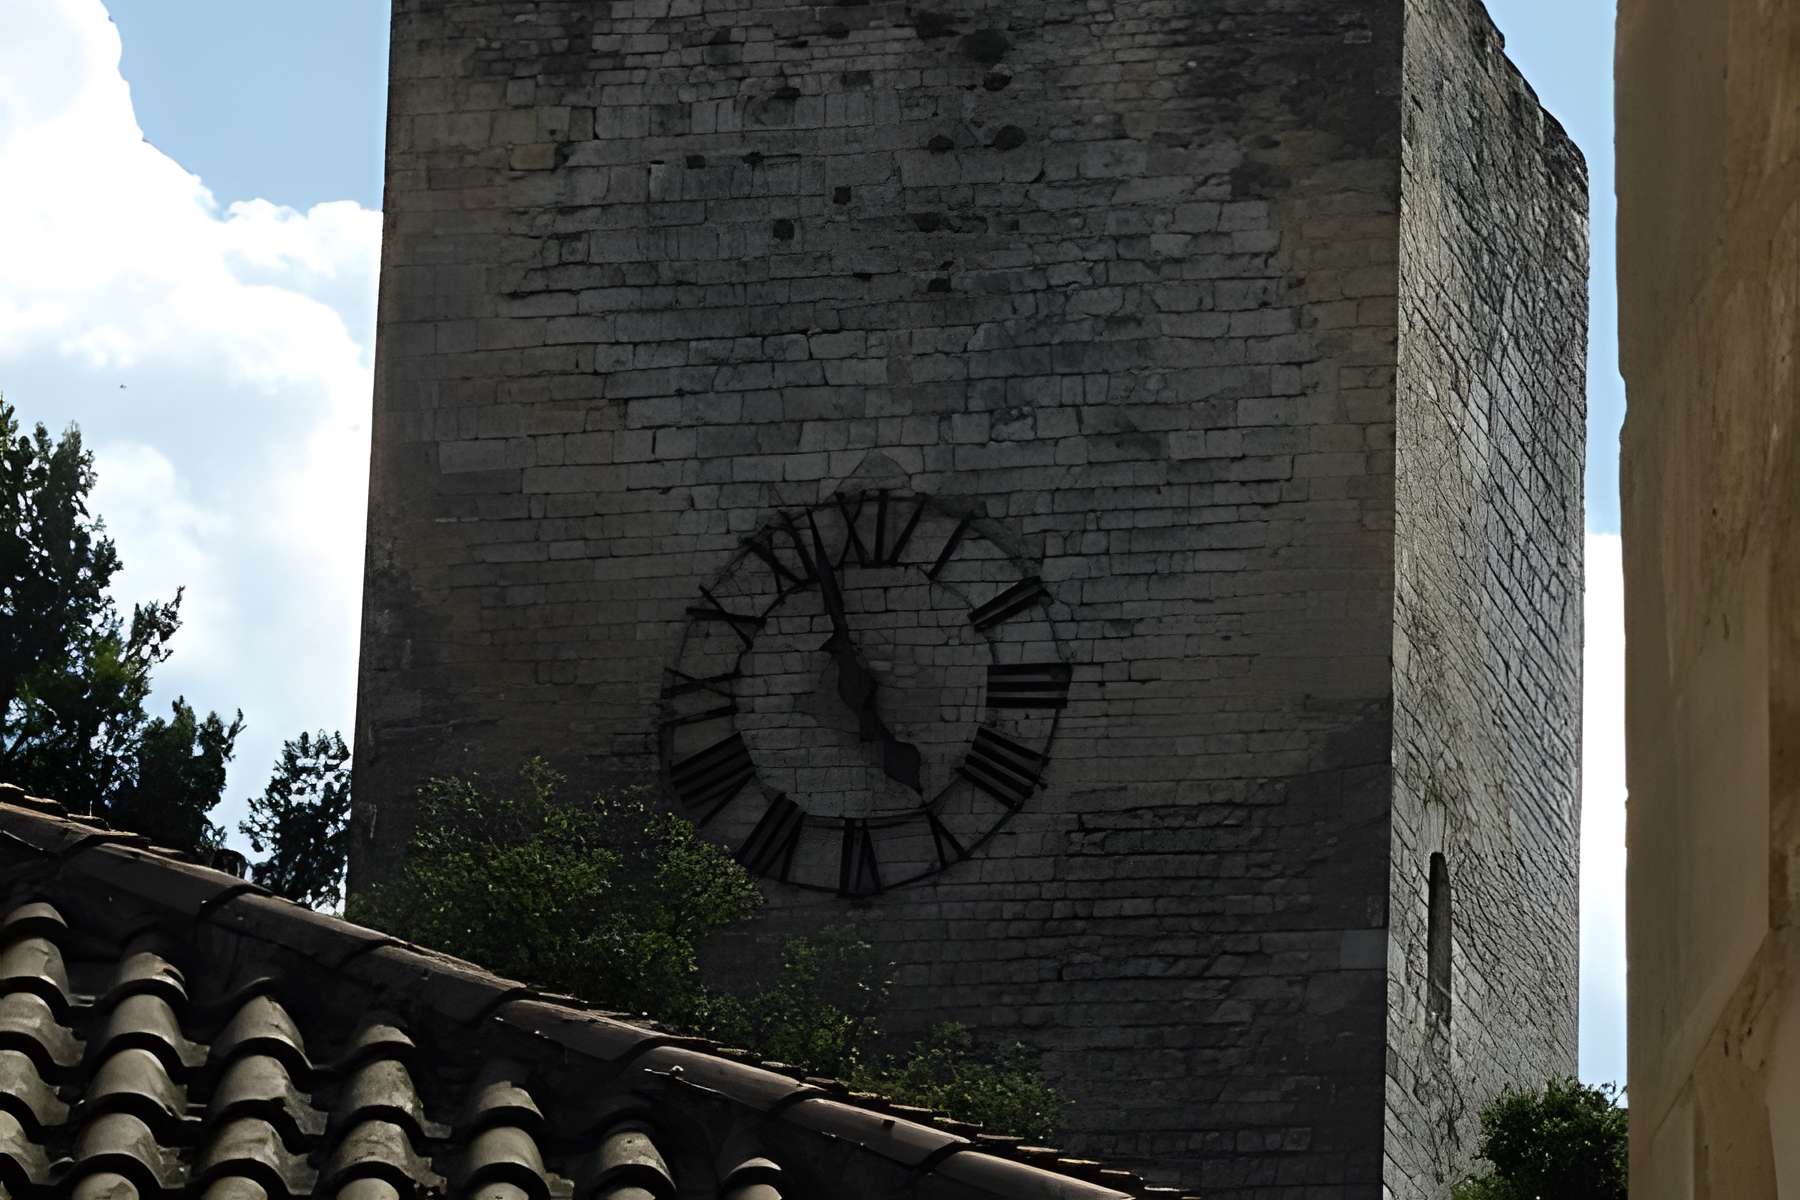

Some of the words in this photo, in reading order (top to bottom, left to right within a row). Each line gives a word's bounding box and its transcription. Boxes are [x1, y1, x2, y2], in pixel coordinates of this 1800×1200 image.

[832, 488, 928, 569] XII
[968, 575, 1042, 633] II
[986, 663, 1073, 708] III
